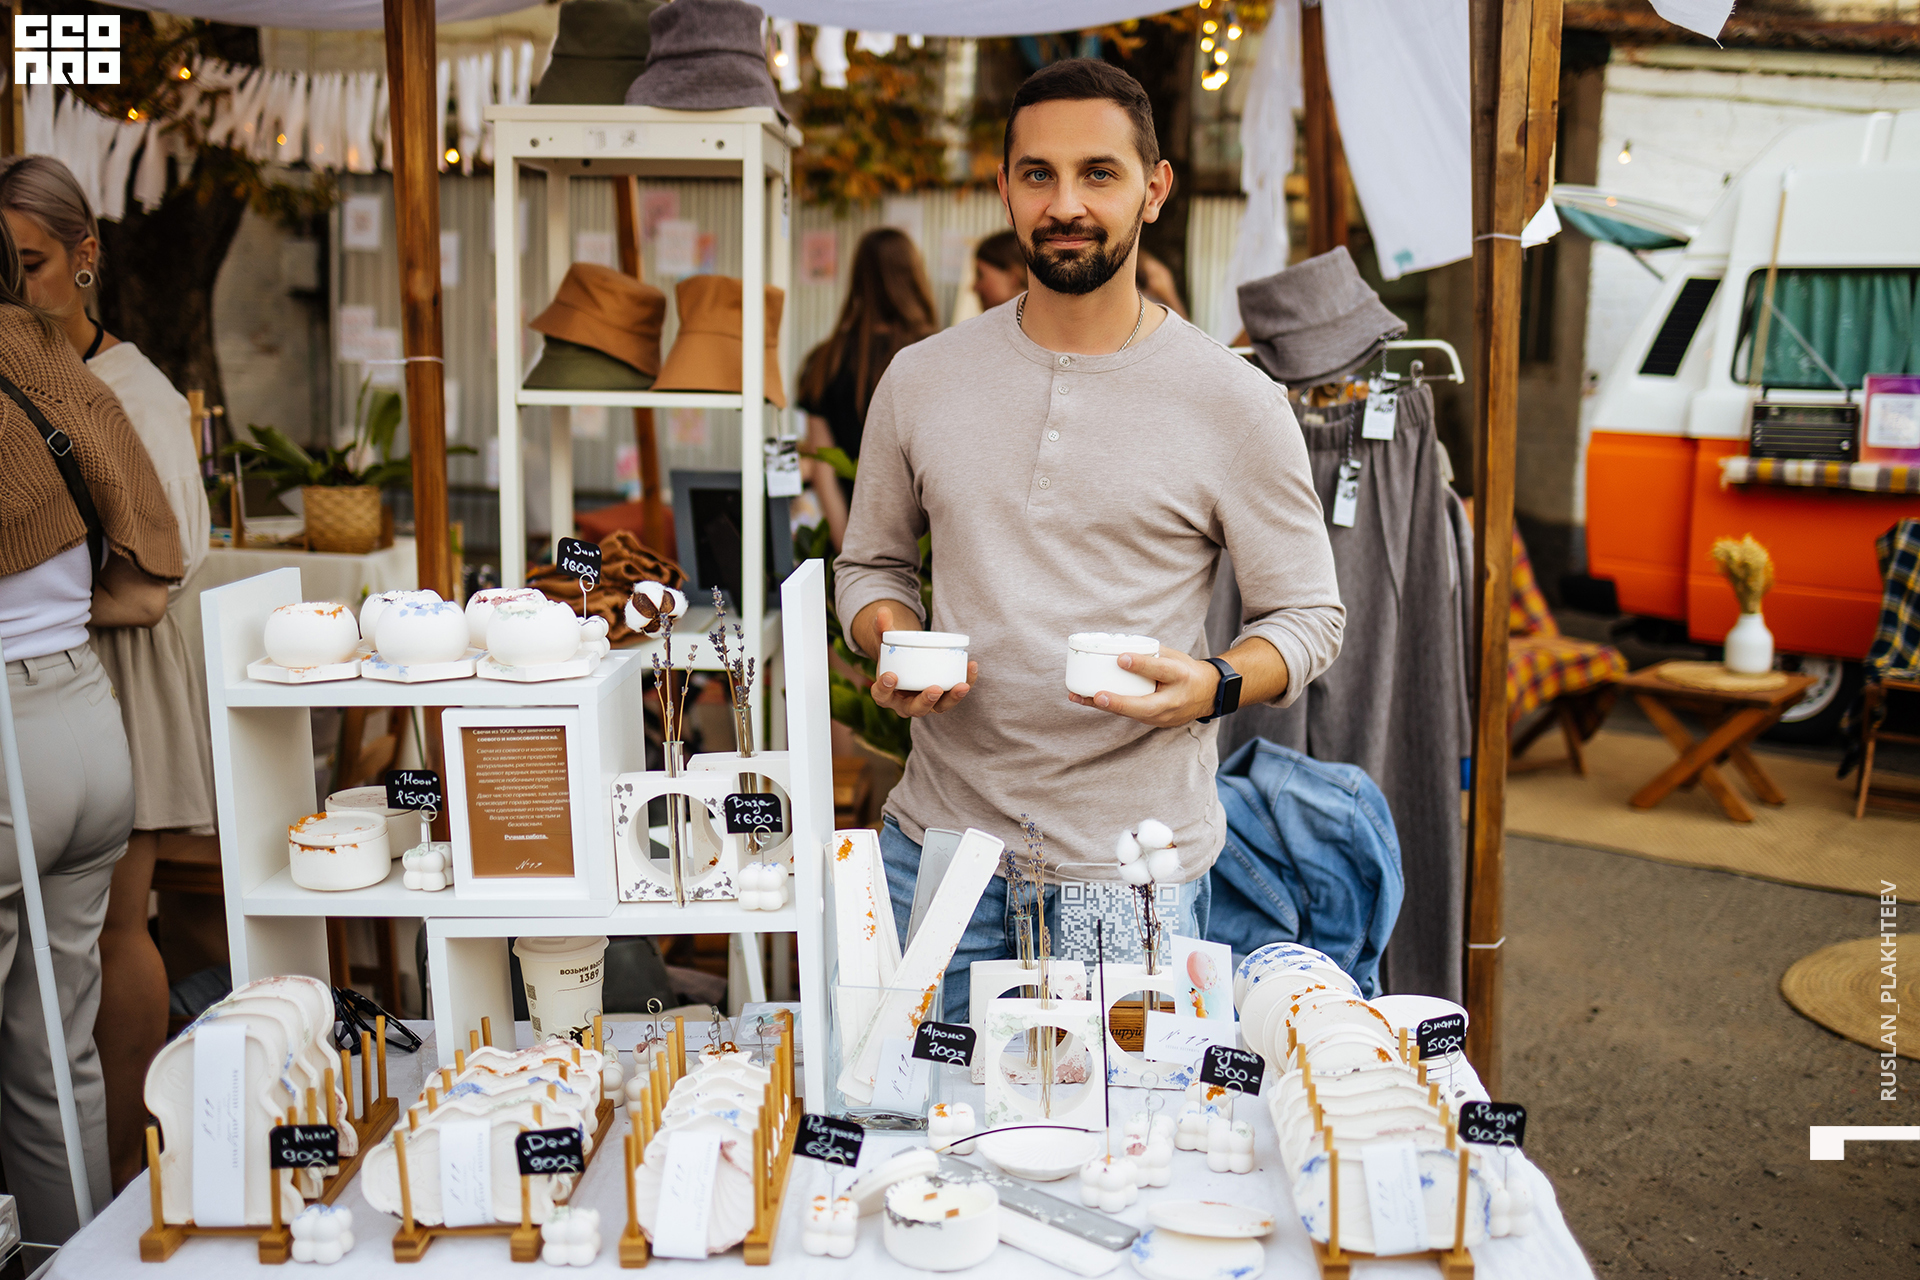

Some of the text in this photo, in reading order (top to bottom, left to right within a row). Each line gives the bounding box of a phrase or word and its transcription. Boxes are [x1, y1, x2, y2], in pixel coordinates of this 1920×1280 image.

[728, 796, 776, 814] Ваза
[560, 965, 588, 976] ВОЗЬМИ
[579, 968, 600, 984] 1389
